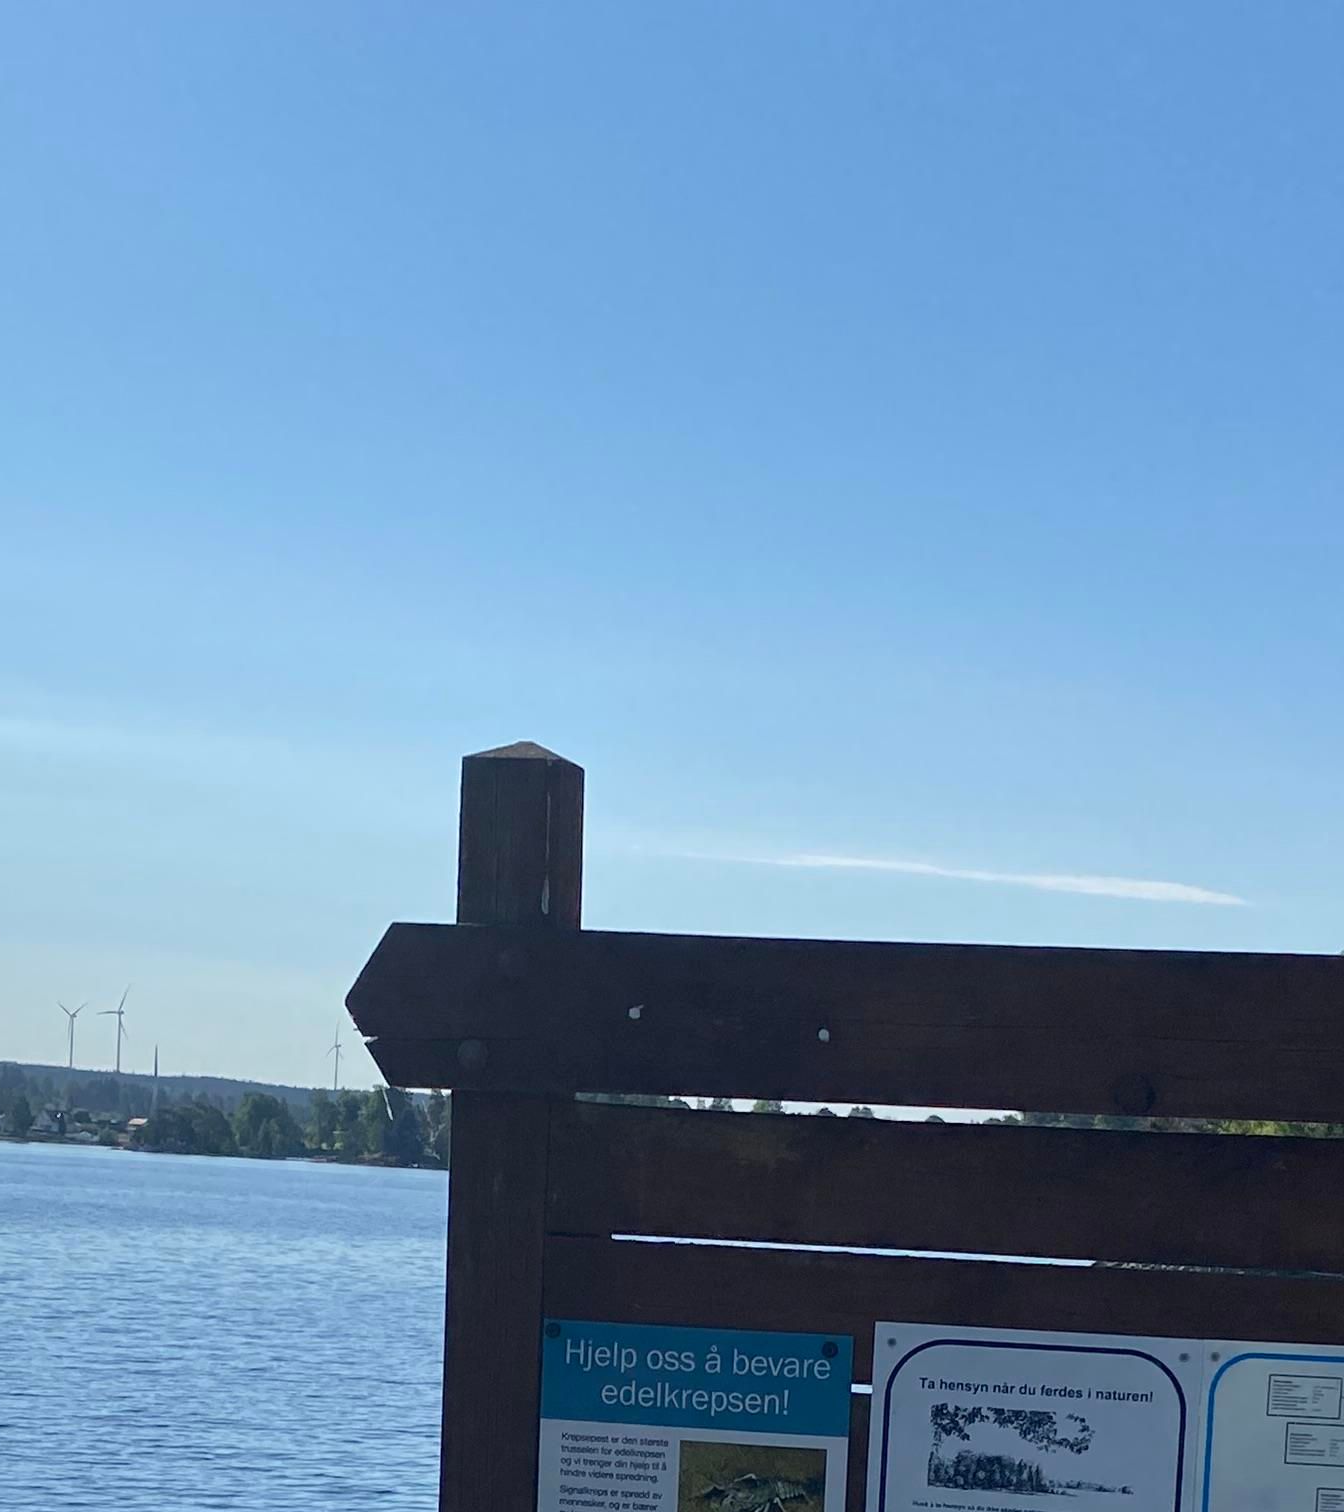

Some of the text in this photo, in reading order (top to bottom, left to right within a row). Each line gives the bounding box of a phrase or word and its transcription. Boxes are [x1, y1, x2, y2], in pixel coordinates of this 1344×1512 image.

[565, 1338, 831, 1380] Hjelp oss å bevare
[600, 1377, 789, 1421] edelkrepsen!
[919, 1377, 935, 1389] Ta
[939, 1378, 988, 1395] hensyn
[992, 1381, 1015, 1394] når
[1018, 1383, 1036, 1395] du
[1040, 1384, 1083, 1398] ferdes
[1095, 1388, 1153, 1402] naturen!
